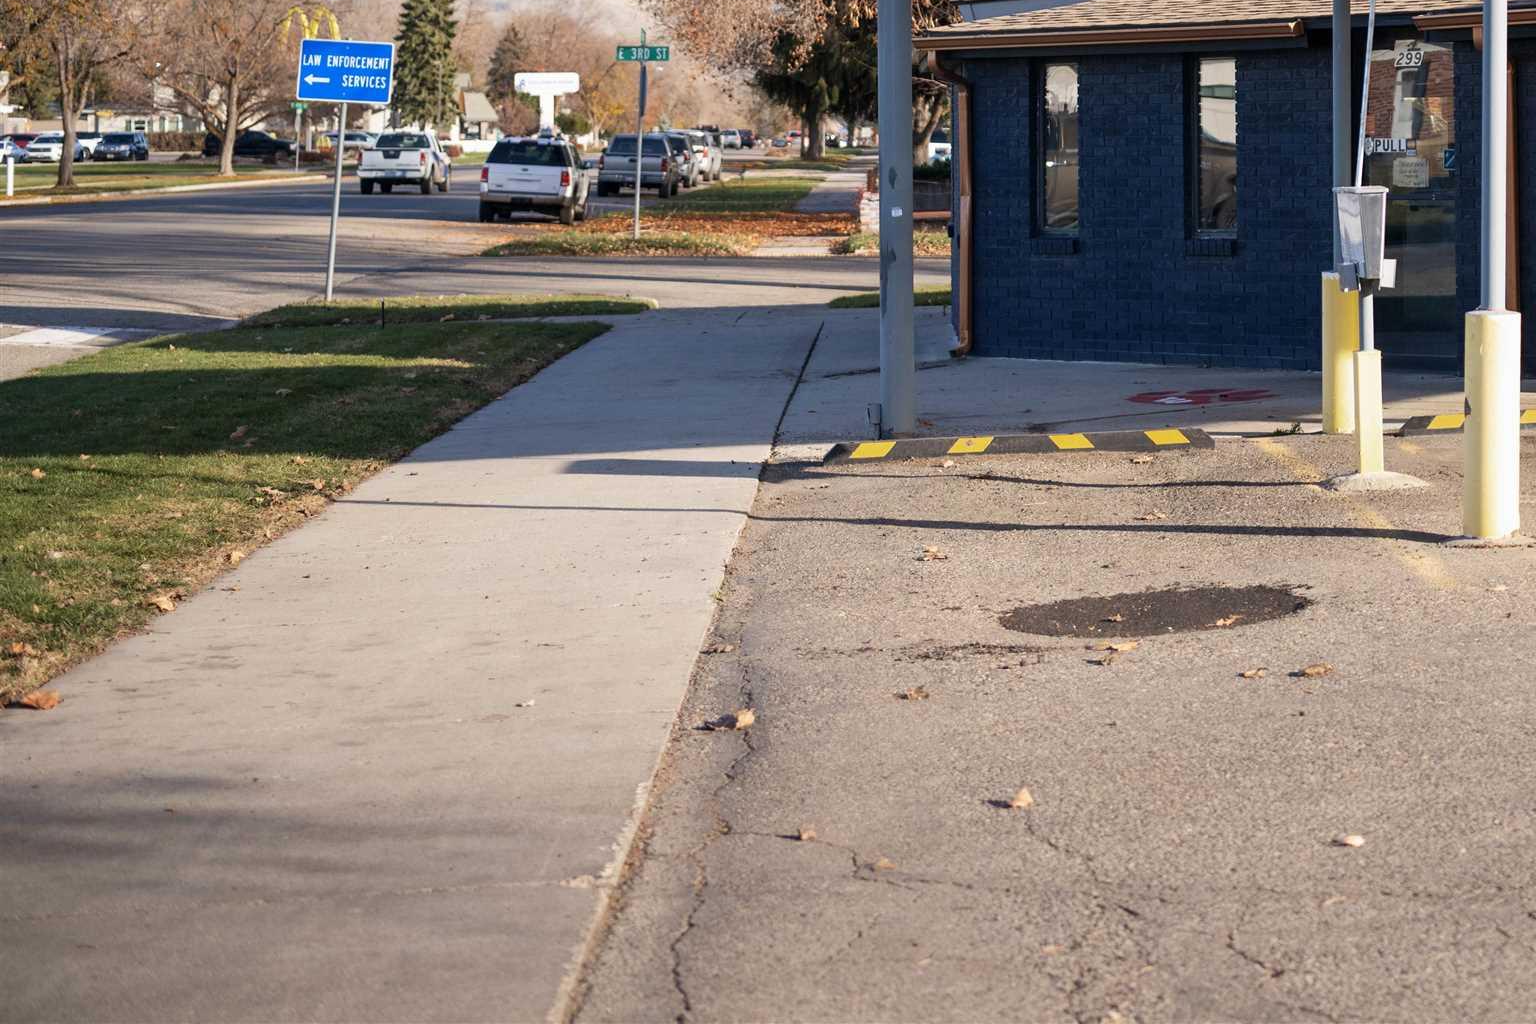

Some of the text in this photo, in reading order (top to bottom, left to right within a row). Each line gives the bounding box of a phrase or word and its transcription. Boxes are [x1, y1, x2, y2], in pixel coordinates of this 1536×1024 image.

[618, 47, 668, 60] E 3RD ST
[1396, 52, 1422, 65] 299
[303, 54, 390, 70] LAW ENFORCEMENT
[342, 74, 386, 89] SERVICES
[1375, 139, 1406, 152] PULL
